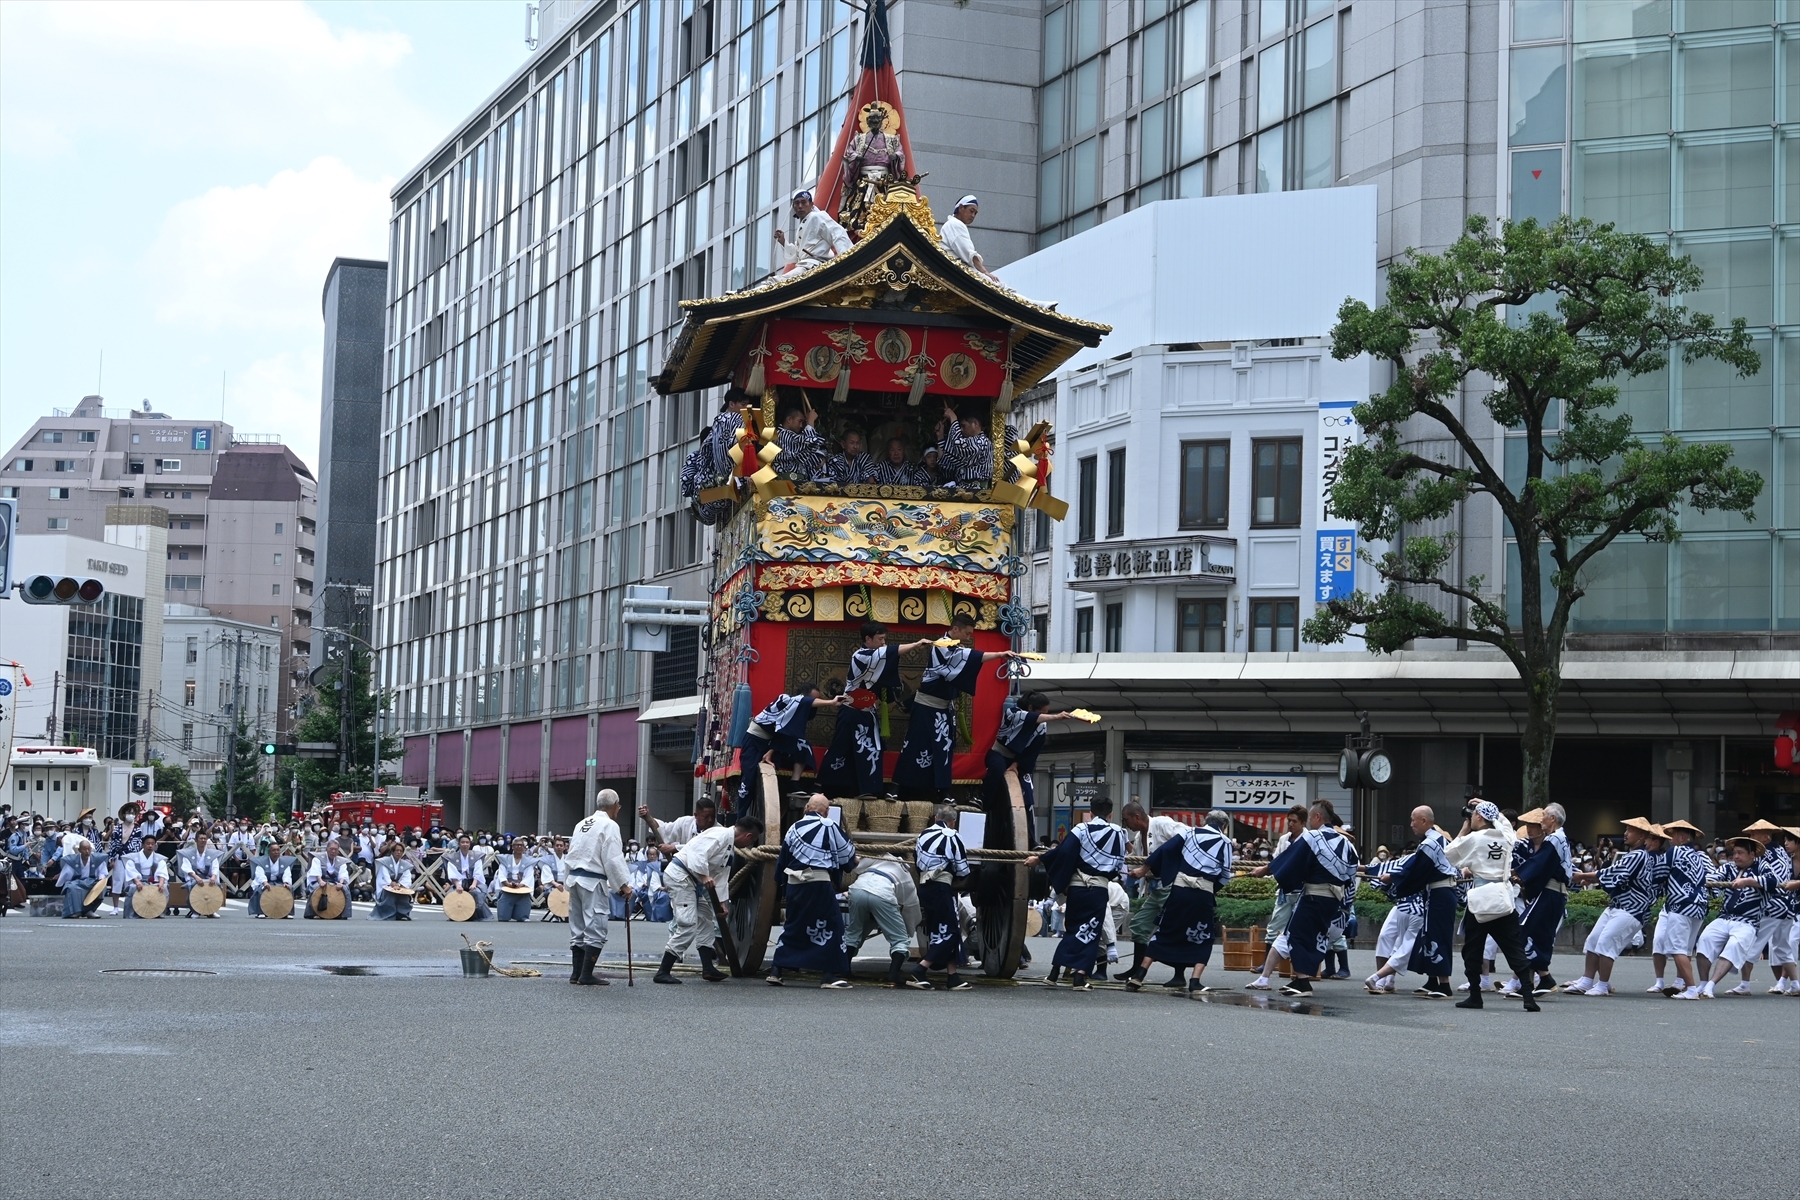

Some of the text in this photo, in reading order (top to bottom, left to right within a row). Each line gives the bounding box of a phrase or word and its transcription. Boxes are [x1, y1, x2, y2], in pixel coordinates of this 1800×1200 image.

[1074, 547, 1193, 578] 池善化粧品店
[1337, 537, 1350, 570] すぐ
[109, 562, 129, 576] SEED
[1319, 536, 1334, 600] 買えます
[1247, 779, 1295, 787] メガネスーパー
[1225, 790, 1295, 805] コンタクト
